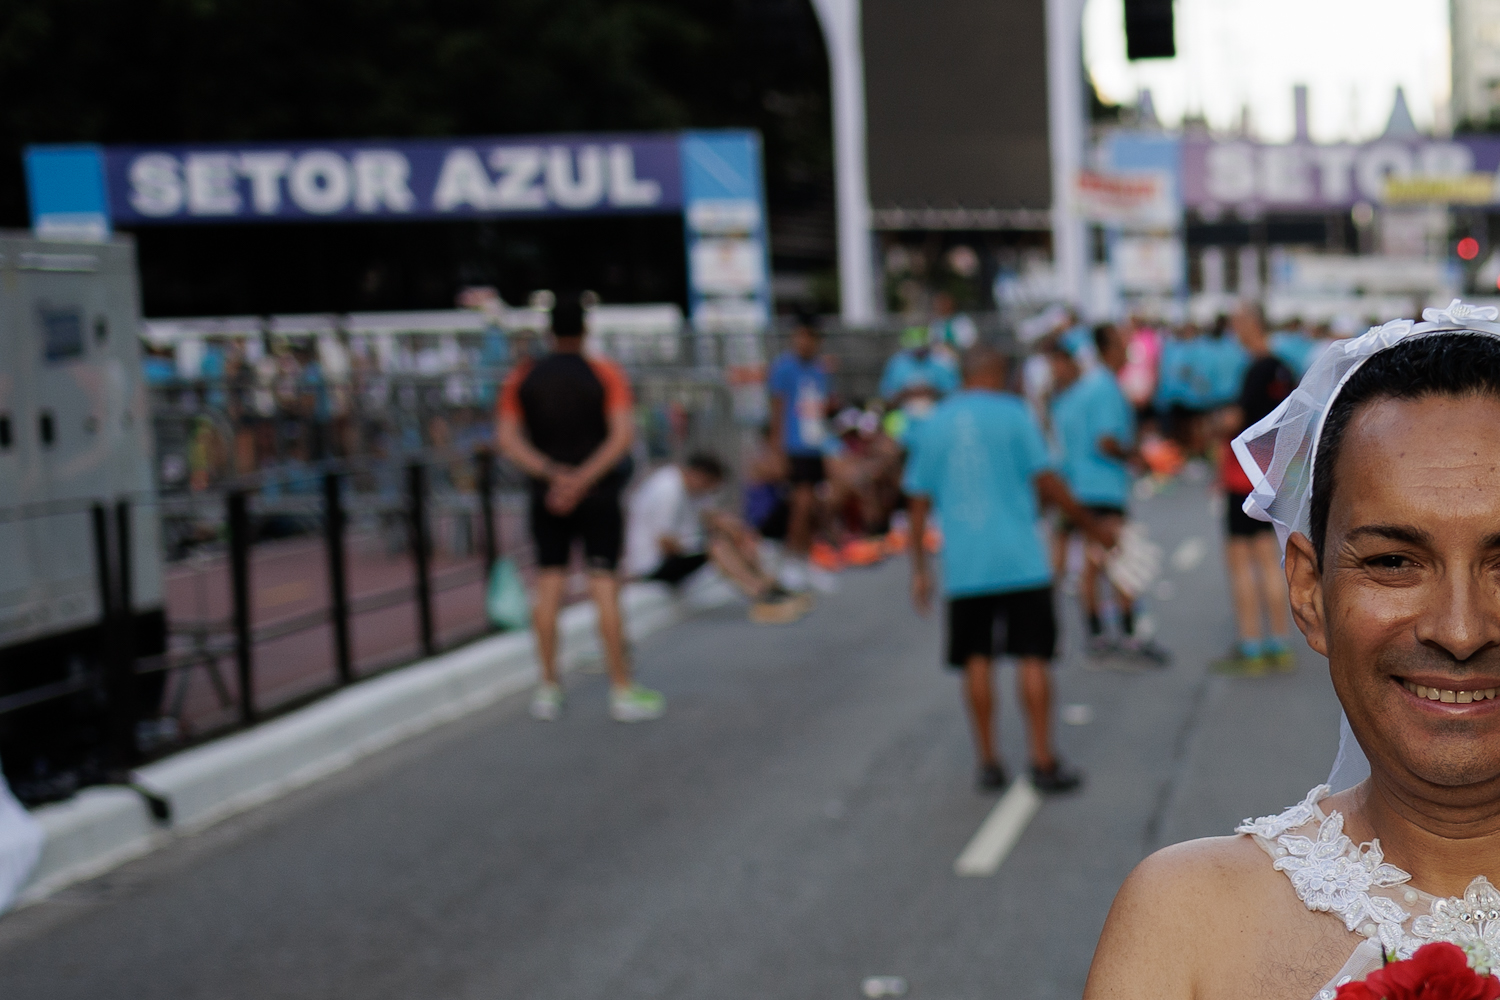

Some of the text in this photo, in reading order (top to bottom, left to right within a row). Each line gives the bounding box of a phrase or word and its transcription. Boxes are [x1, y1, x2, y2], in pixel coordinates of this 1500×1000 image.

[129, 143, 662, 218] SETOR AZUL
[1204, 141, 1475, 199] SETOR
